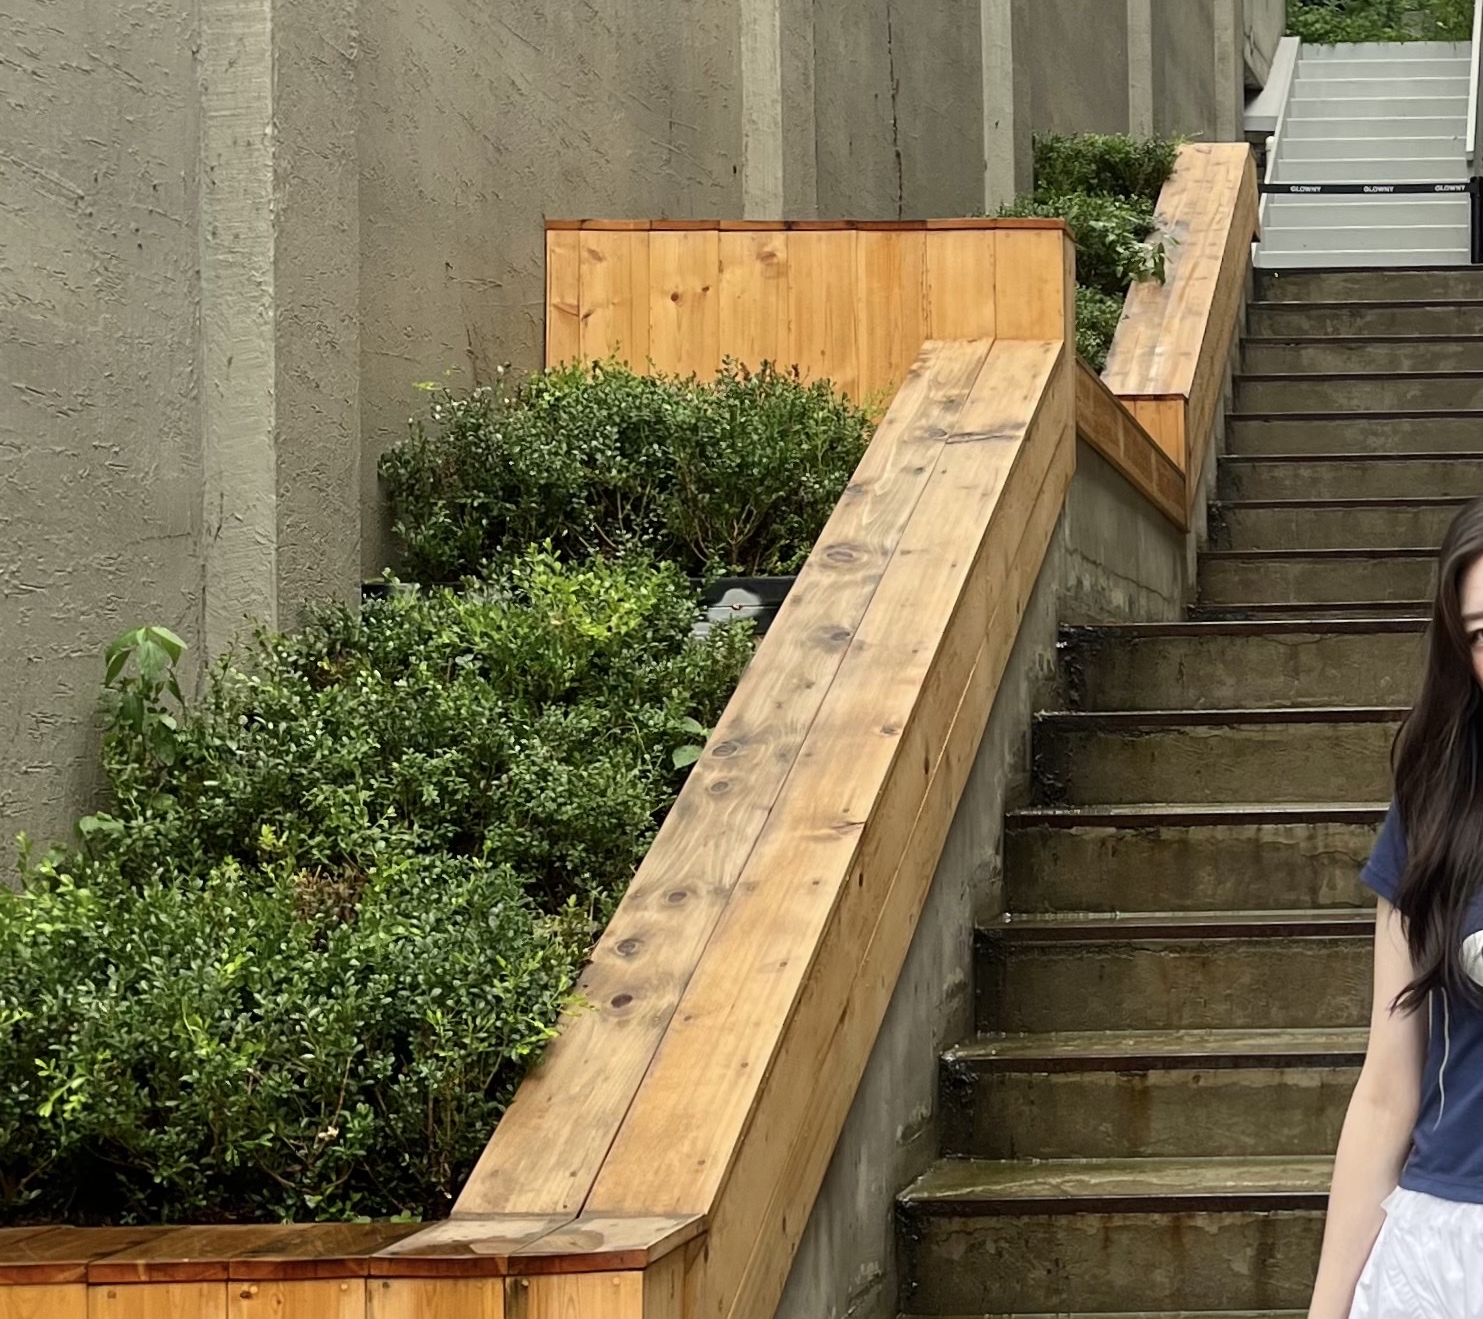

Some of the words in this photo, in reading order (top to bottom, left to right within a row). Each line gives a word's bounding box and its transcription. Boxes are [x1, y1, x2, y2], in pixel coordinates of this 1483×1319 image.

[1289, 185, 1322, 193] GLOWNY
[1363, 185, 1395, 193] GLOWNY
[1434, 184, 1466, 192] GLOWNY
